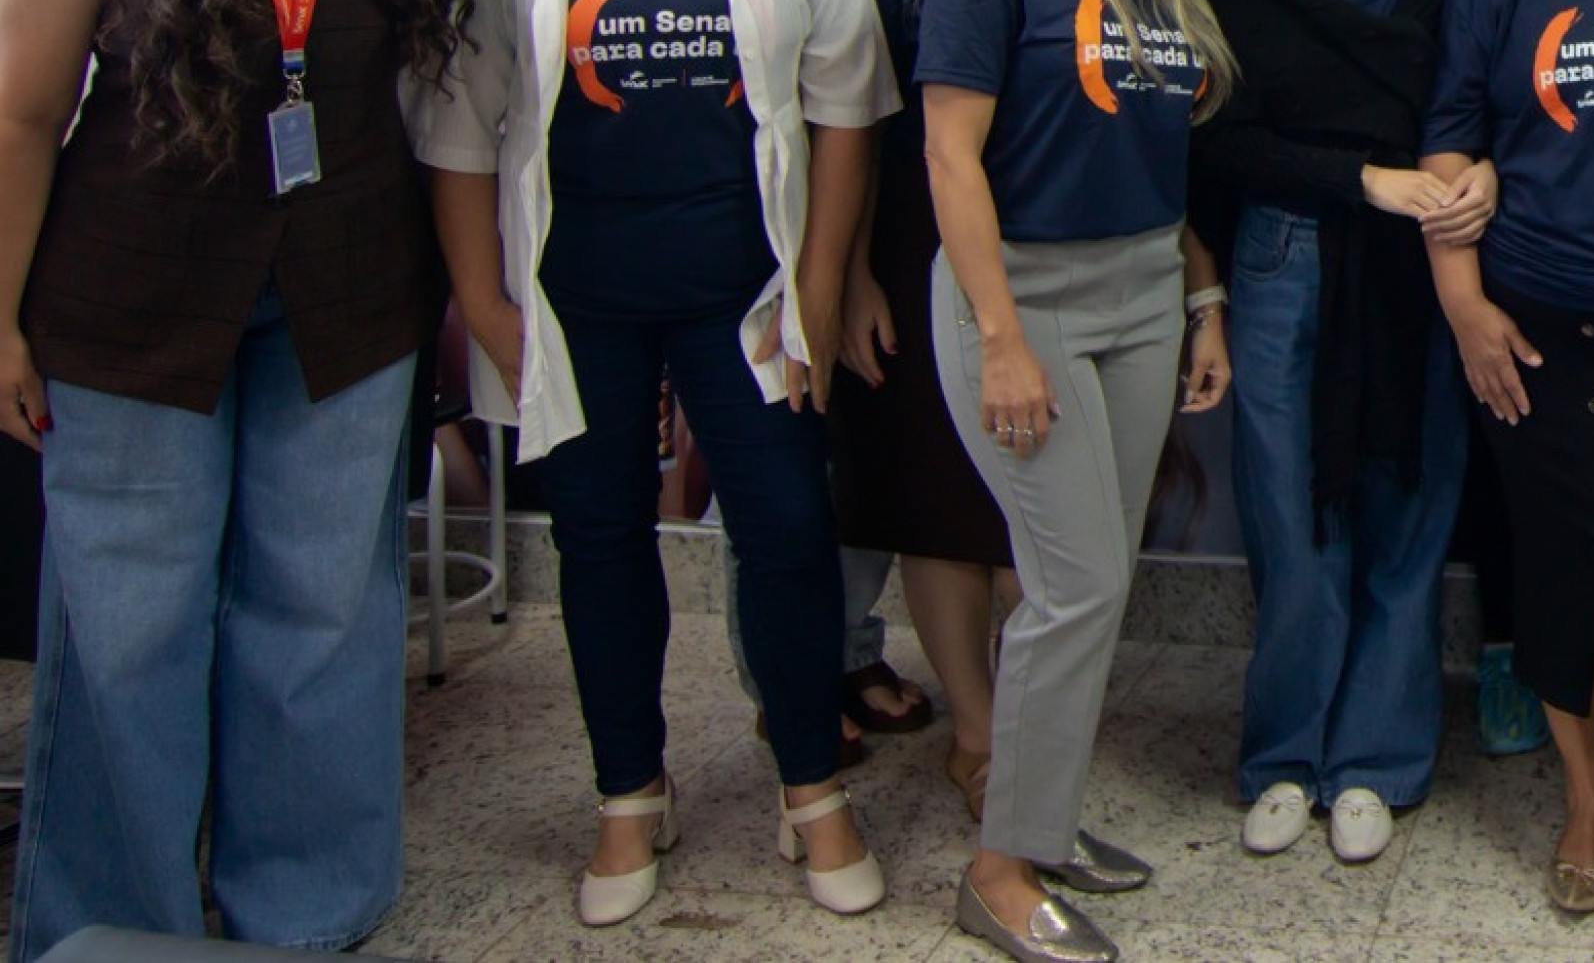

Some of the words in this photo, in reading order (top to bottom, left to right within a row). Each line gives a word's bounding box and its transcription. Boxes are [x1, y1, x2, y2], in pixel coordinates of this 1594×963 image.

[598, 15, 645, 36] um
[655, 10, 733, 33] Sena
[1137, 22, 1186, 43] Sena
[572, 43, 643, 65] para
[649, 36, 723, 59] cada
[1540, 63, 1594, 90] para
